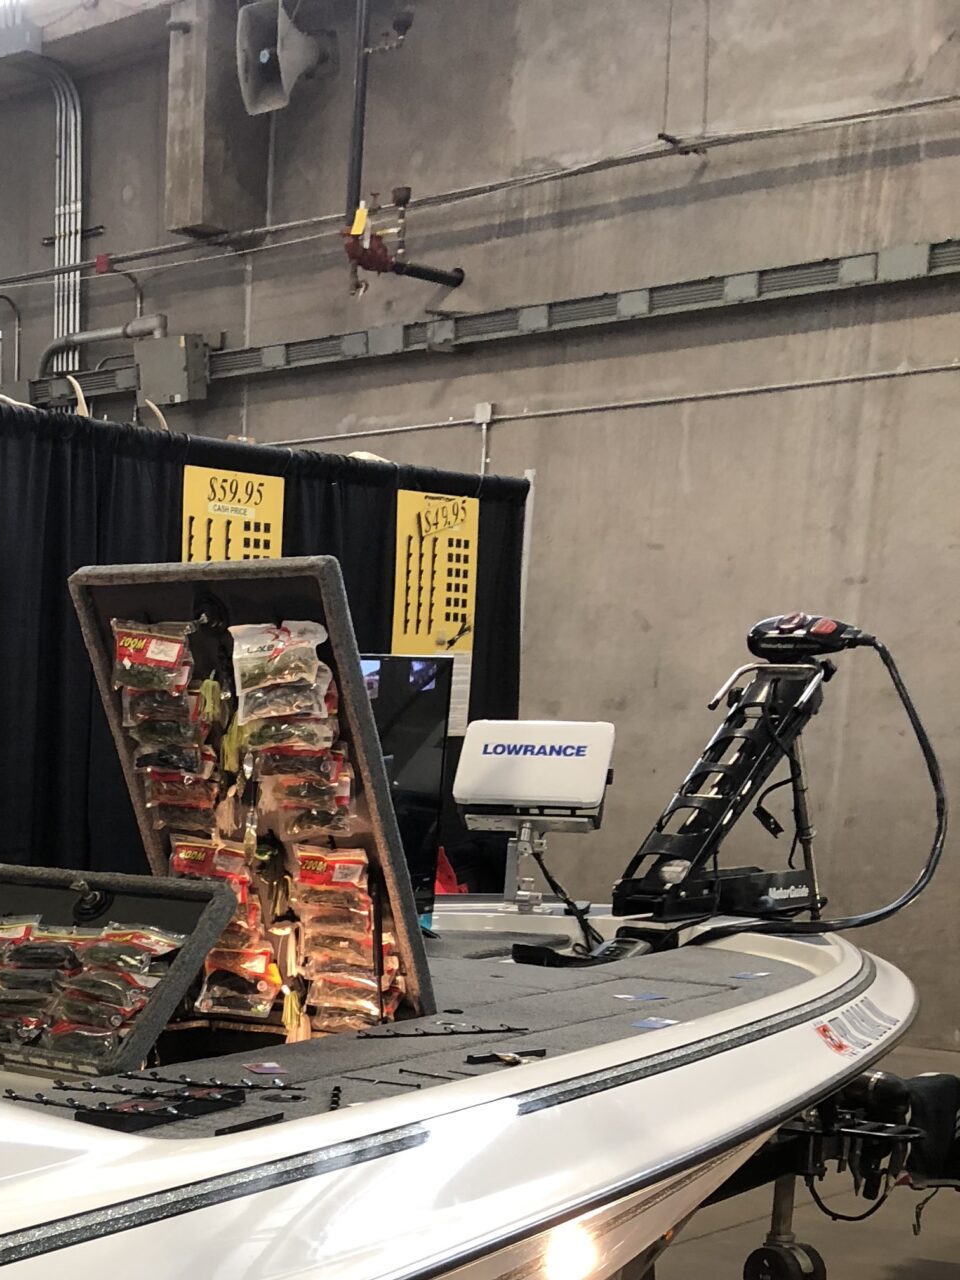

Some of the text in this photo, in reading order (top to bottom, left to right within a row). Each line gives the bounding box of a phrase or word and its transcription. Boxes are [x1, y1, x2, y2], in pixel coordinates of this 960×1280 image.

[208, 476, 265, 506] $59.95
[213, 504, 248, 516] CASH PRICE
[119, 635, 147, 650] ZOOM
[482, 743, 587, 757] LOWRANCE
[301, 858, 328, 873] ZOOM
[768, 884, 809, 900] MotorGuide
